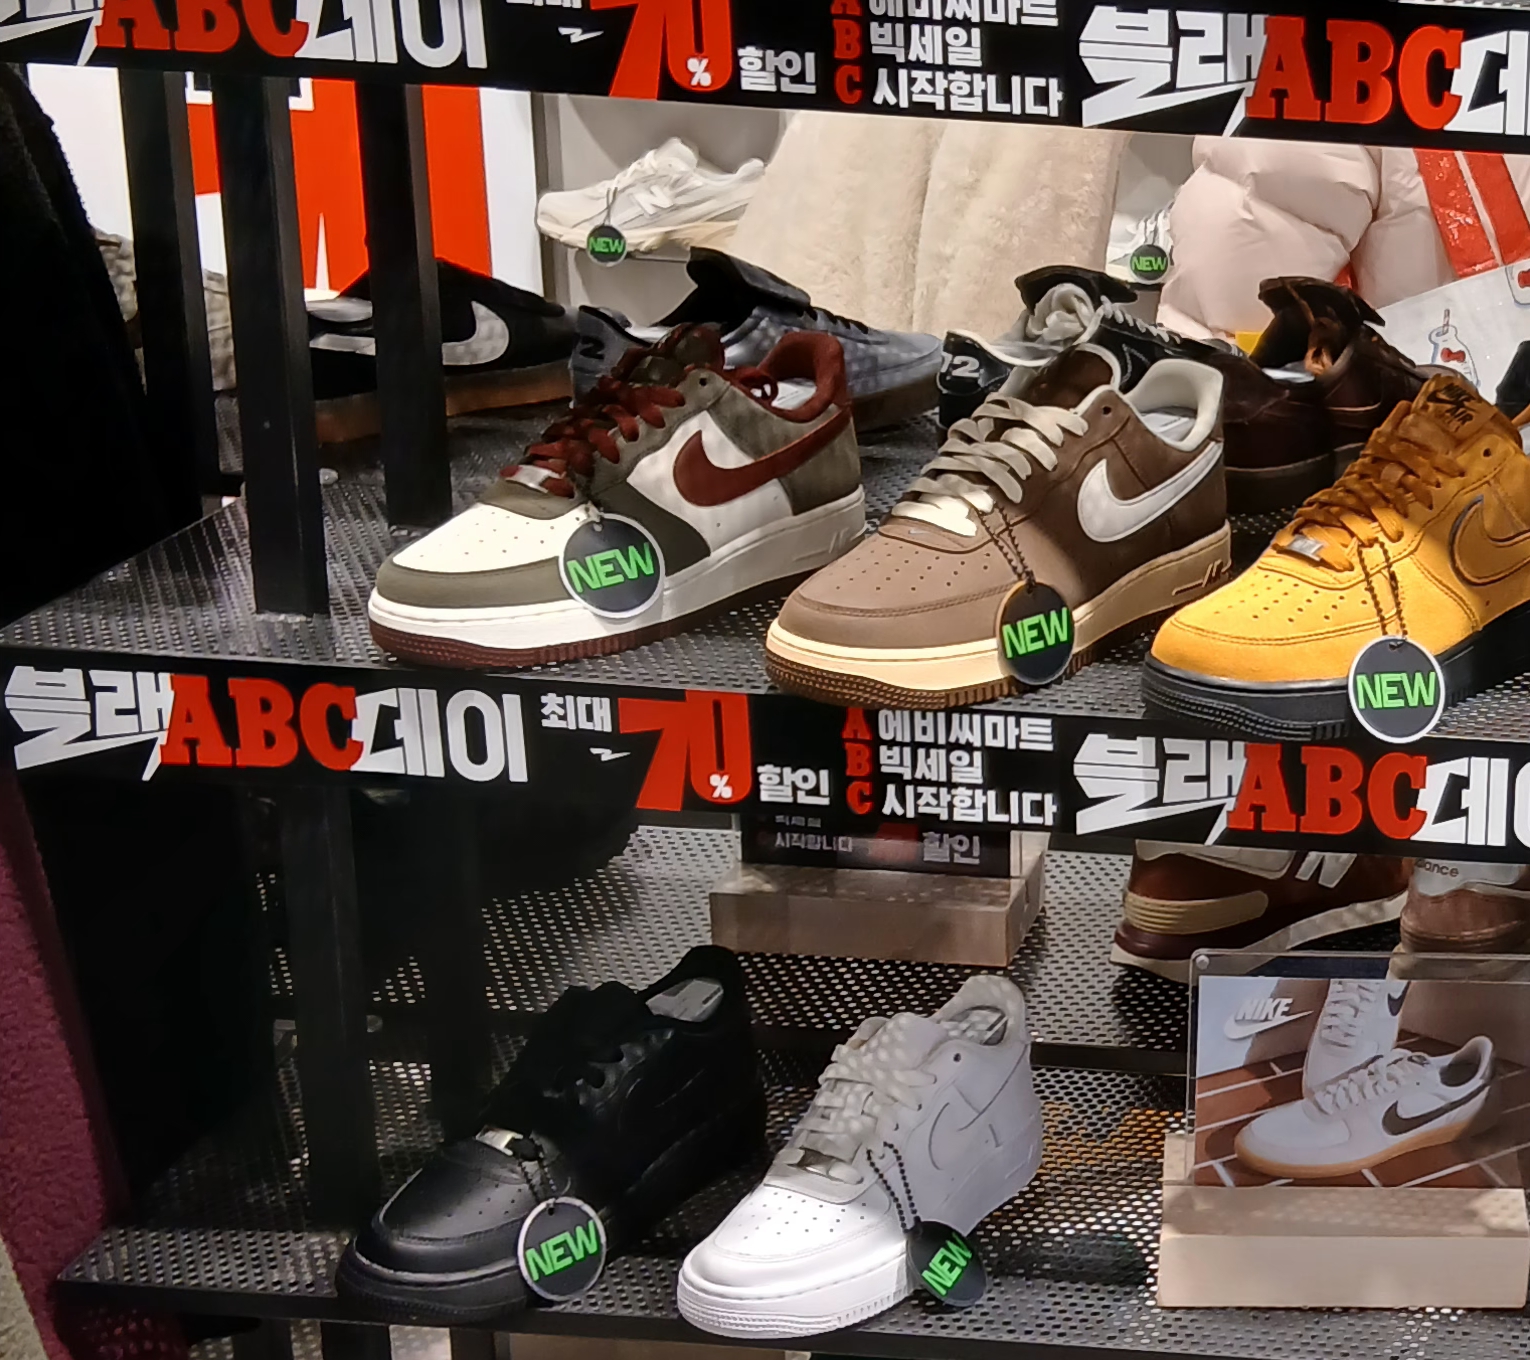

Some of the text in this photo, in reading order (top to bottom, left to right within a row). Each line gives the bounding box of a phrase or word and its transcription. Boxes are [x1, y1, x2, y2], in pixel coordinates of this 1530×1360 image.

[833, 20, 983, 68] B 빅세일
[738, 47, 816, 95] 할인
[834, 65, 1062, 118] C 시작합니다
[589, 238, 625, 254] NEW
[1131, 256, 1167, 272] NEW
[567, 543, 655, 593] NEW
[1003, 607, 1069, 658] NEW
[1356, 671, 1436, 710] NEW
[540, 692, 613, 734] 최대
[756, 763, 831, 806] 할인
[841, 707, 1055, 753] A 에비씨마트
[844, 743, 984, 786] B 빅세일
[845, 782, 1058, 827] C 시작합니다
[923, 830, 981, 866] 할인
[1235, 997, 1292, 1021] NIKE
[525, 1222, 597, 1281] NEW
[921, 1232, 972, 1296] NEW
